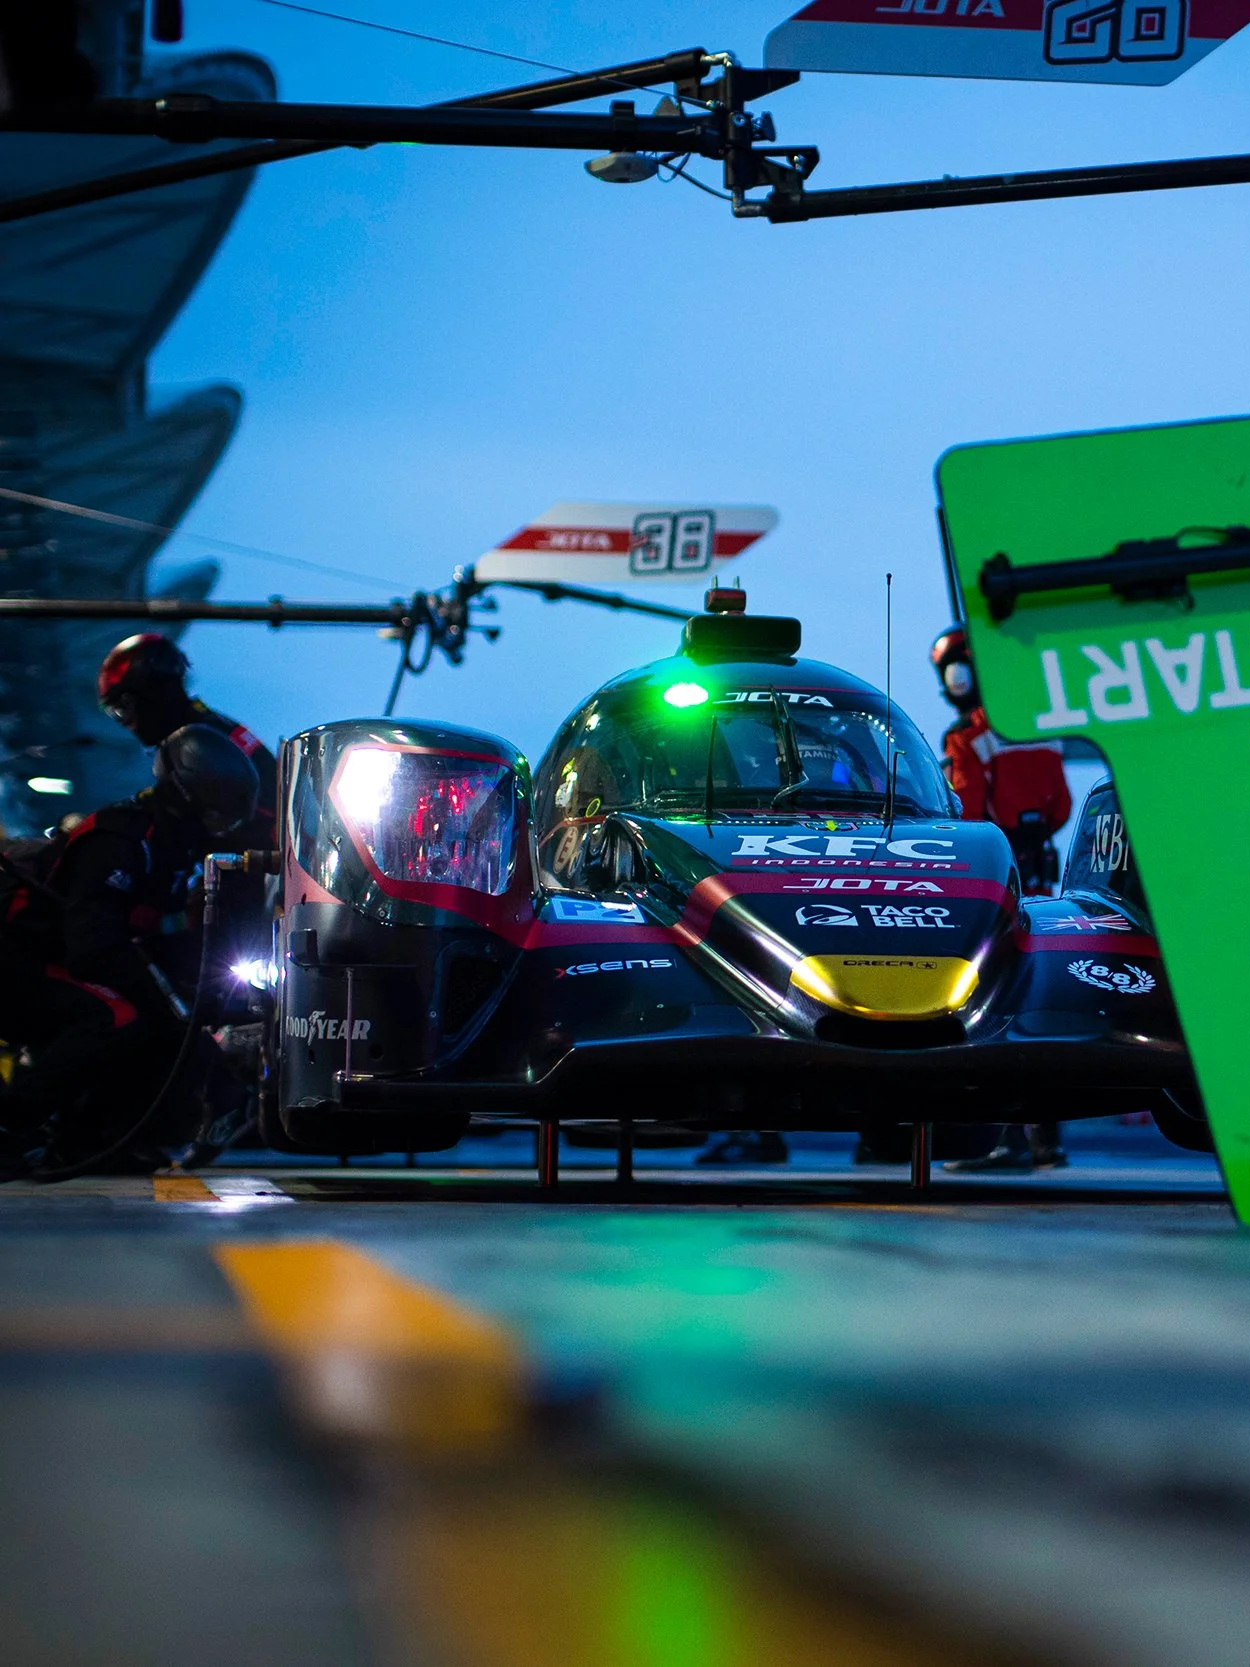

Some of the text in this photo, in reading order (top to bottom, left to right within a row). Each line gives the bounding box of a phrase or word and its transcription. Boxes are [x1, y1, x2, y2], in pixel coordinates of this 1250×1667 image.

[712, 691, 834, 708] JOTA
[731, 835, 957, 860] KFC
[782, 877, 945, 893] JOTA
[860, 905, 950, 917] TACO
[872, 915, 956, 928] BELL
